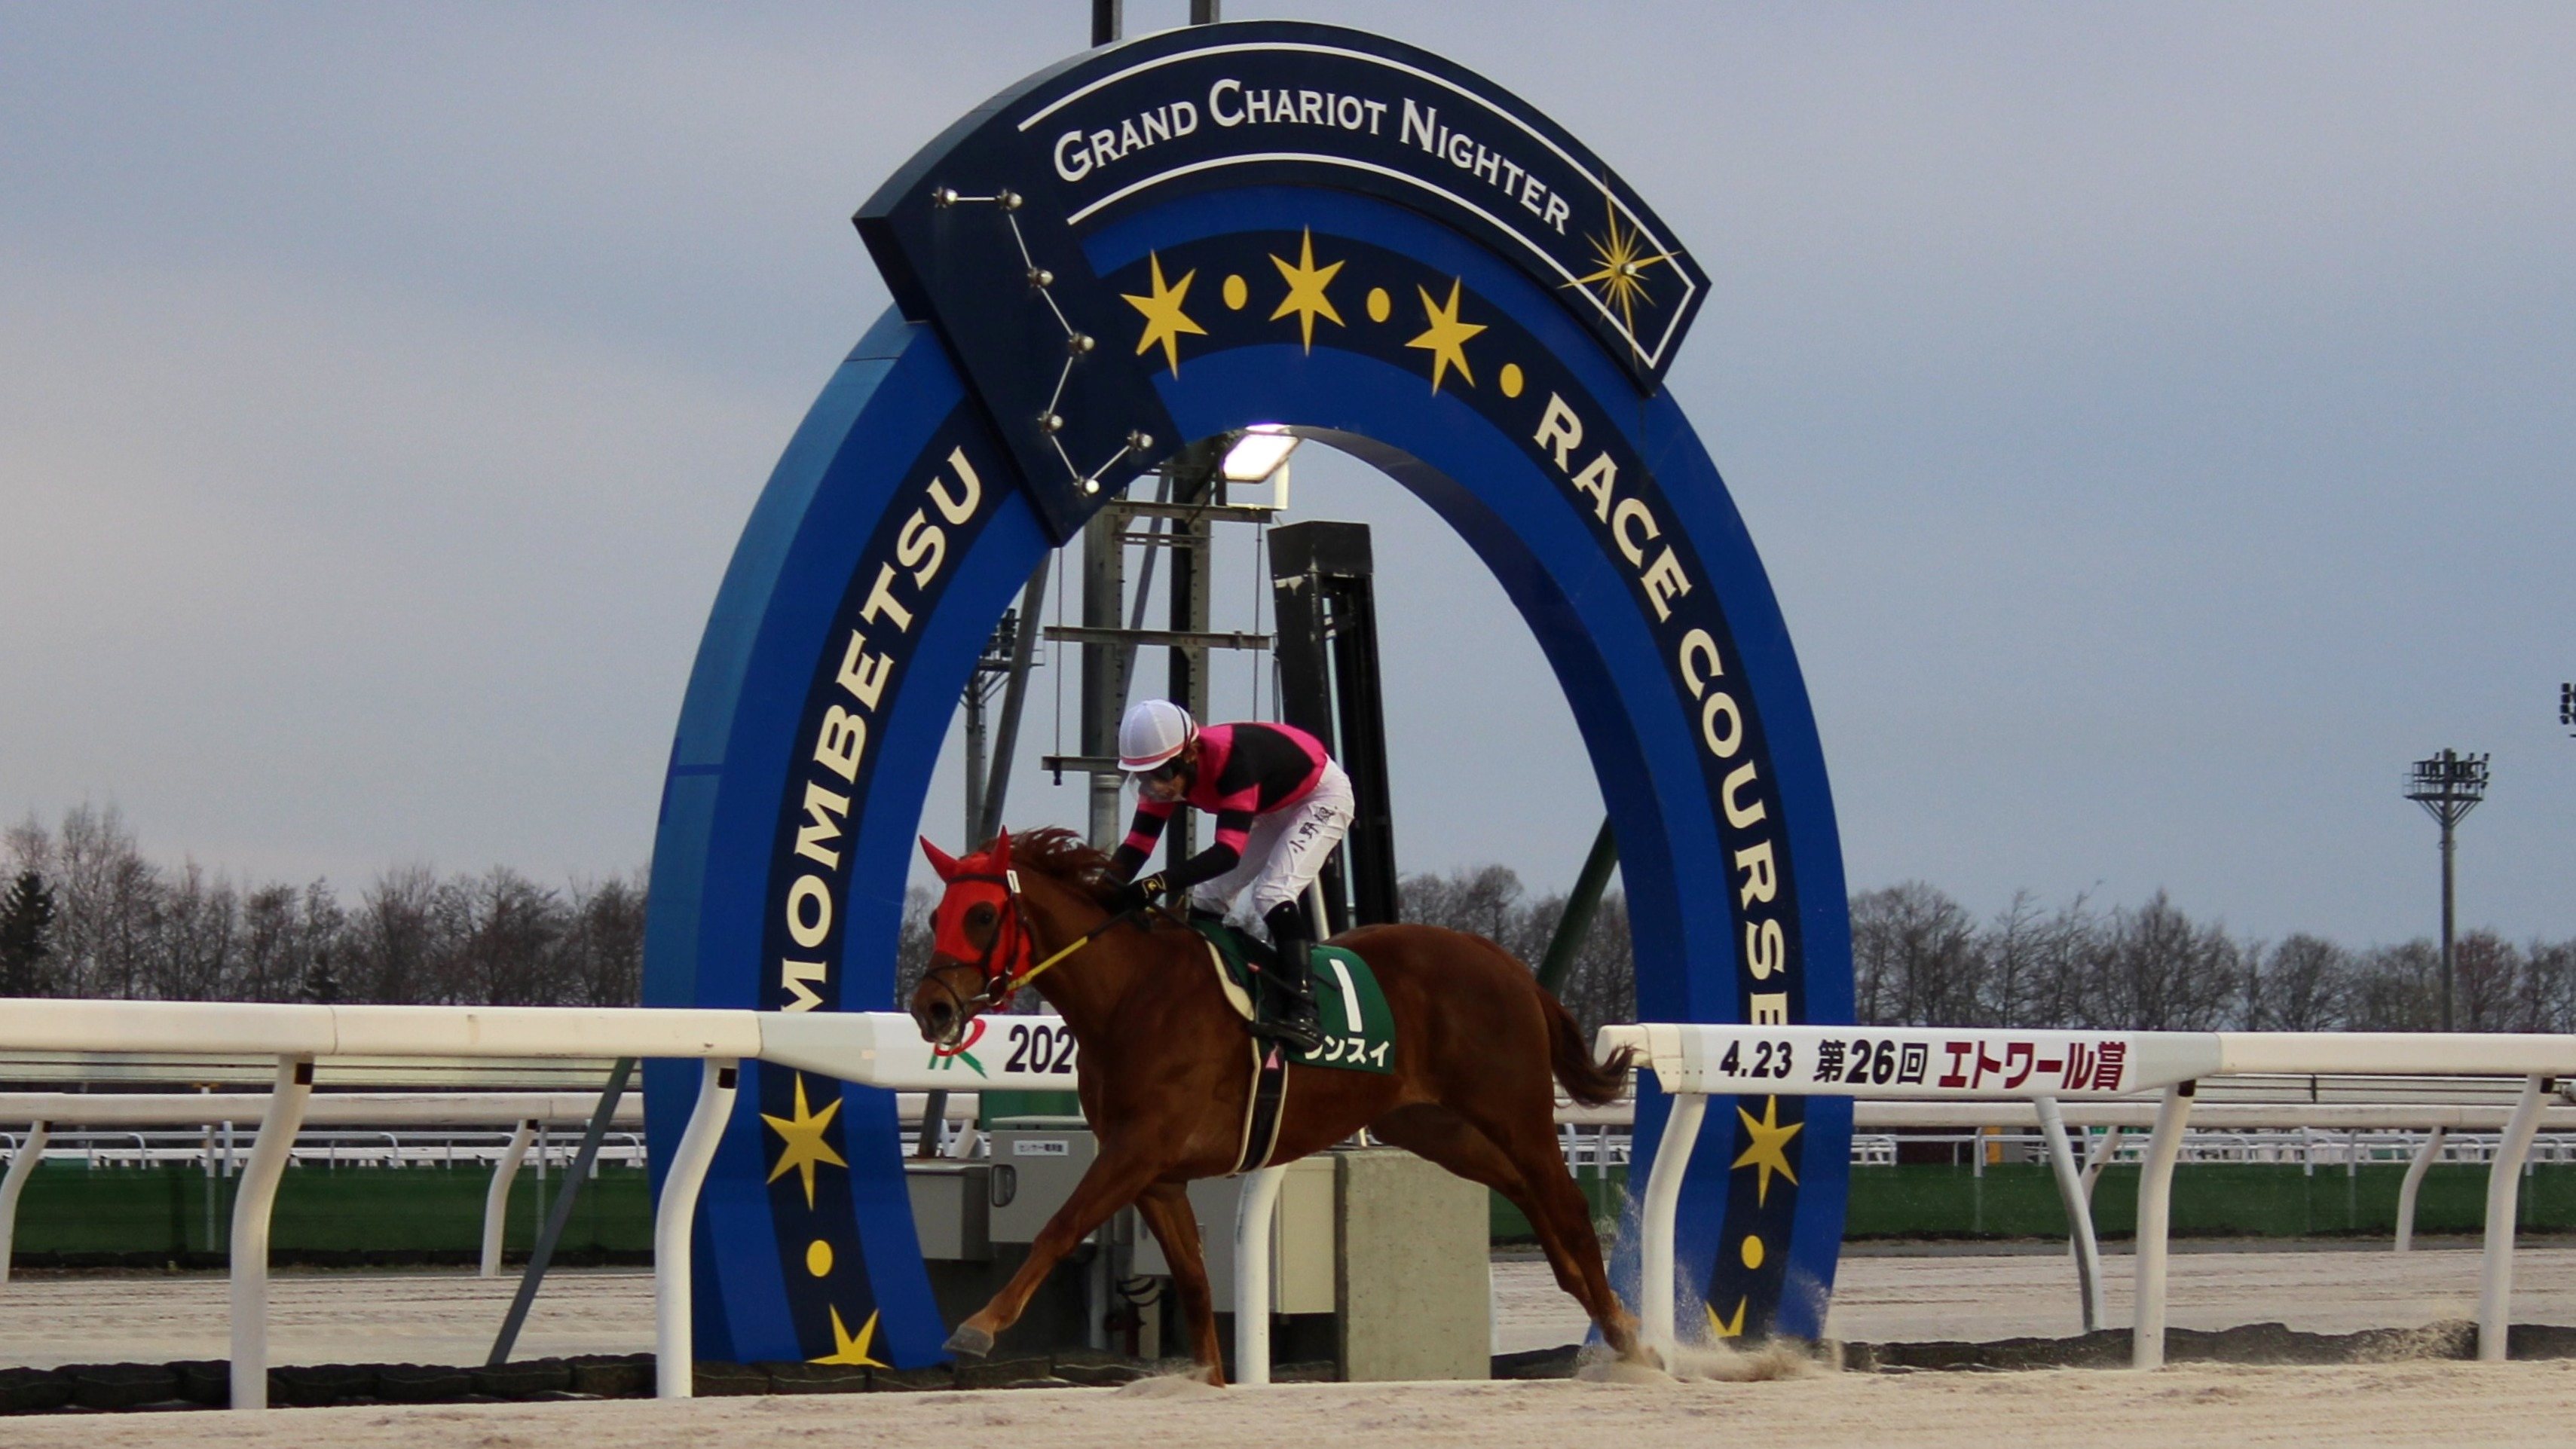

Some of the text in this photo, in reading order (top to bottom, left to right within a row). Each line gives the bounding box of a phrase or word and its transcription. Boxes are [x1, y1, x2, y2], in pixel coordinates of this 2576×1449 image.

[780, 446, 981, 1013] MOMBETSU
[1534, 392, 1788, 1025] RACE COURSE
[1329, 958, 1363, 1032] 1
[1005, 1024, 1078, 1074] 202
[1719, 1039, 2126, 1091] 4.23 第26回 エトワール賞
